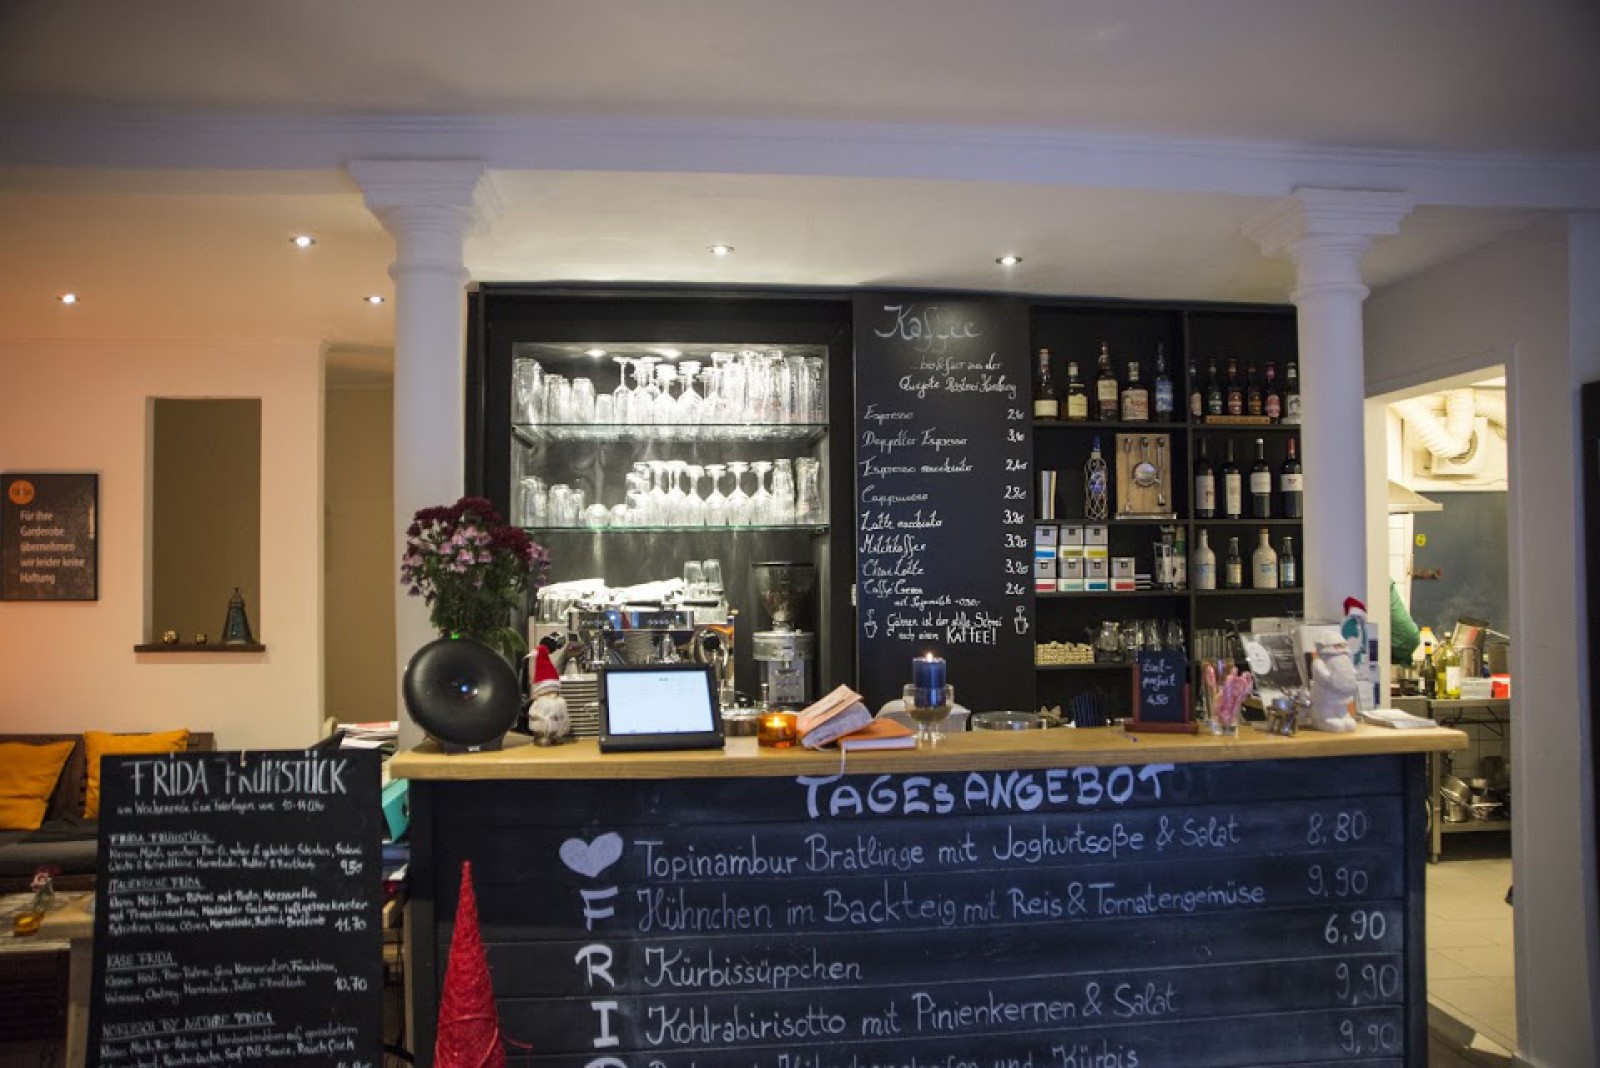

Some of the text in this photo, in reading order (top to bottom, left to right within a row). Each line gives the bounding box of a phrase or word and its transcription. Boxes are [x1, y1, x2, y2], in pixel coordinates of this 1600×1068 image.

[873, 304, 984, 350] Kaffee
[863, 403, 914, 425] Espresso
[920, 427, 968, 451] Espresso
[859, 455, 916, 479] Espresso
[860, 510, 895, 531] Latte
[121, 750, 209, 796] FRIDA
[634, 835, 798, 881] Topinambur
[804, 832, 925, 872] Bratlinge
[938, 832, 978, 864] mit
[992, 823, 1144, 863] Joghurtsoße
[1155, 815, 1175, 851] &
[1182, 814, 1240, 848] Salat
[637, 887, 772, 932] Hühnchen
[787, 899, 815, 925] im
[823, 880, 956, 927] Backteig
[963, 894, 999, 922] mit
[1007, 887, 1063, 919] Reis
[1067, 882, 1088, 914] &
[1088, 881, 1266, 916] Tomatengemüse
[643, 946, 863, 989] Kürbissüppchen
[646, 1003, 847, 1047] Kohlrabirisotto
[862, 1001, 900, 1036] mit
[911, 991, 1076, 1032] Pinienkernen
[1083, 982, 1103, 1017] &
[1114, 982, 1179, 1019] Salat
[1052, 1039, 1139, 1068] Kürbis
